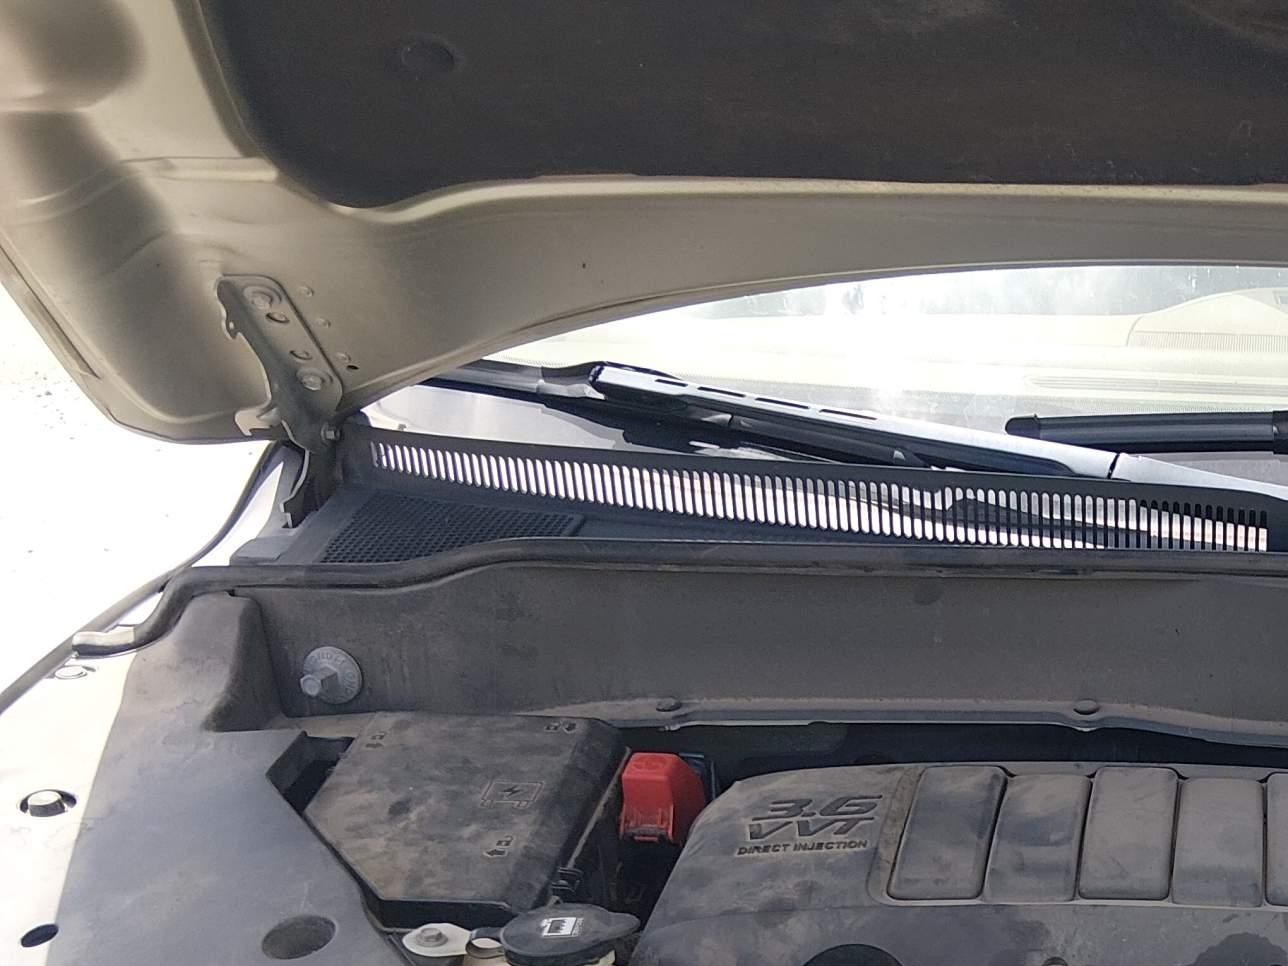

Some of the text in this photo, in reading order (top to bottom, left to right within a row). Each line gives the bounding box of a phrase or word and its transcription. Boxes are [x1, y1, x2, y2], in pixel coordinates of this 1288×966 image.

[751, 794, 884, 822] 3.6
[748, 816, 876, 841] VVT
[736, 839, 868, 856] DIRECT INJECTION
